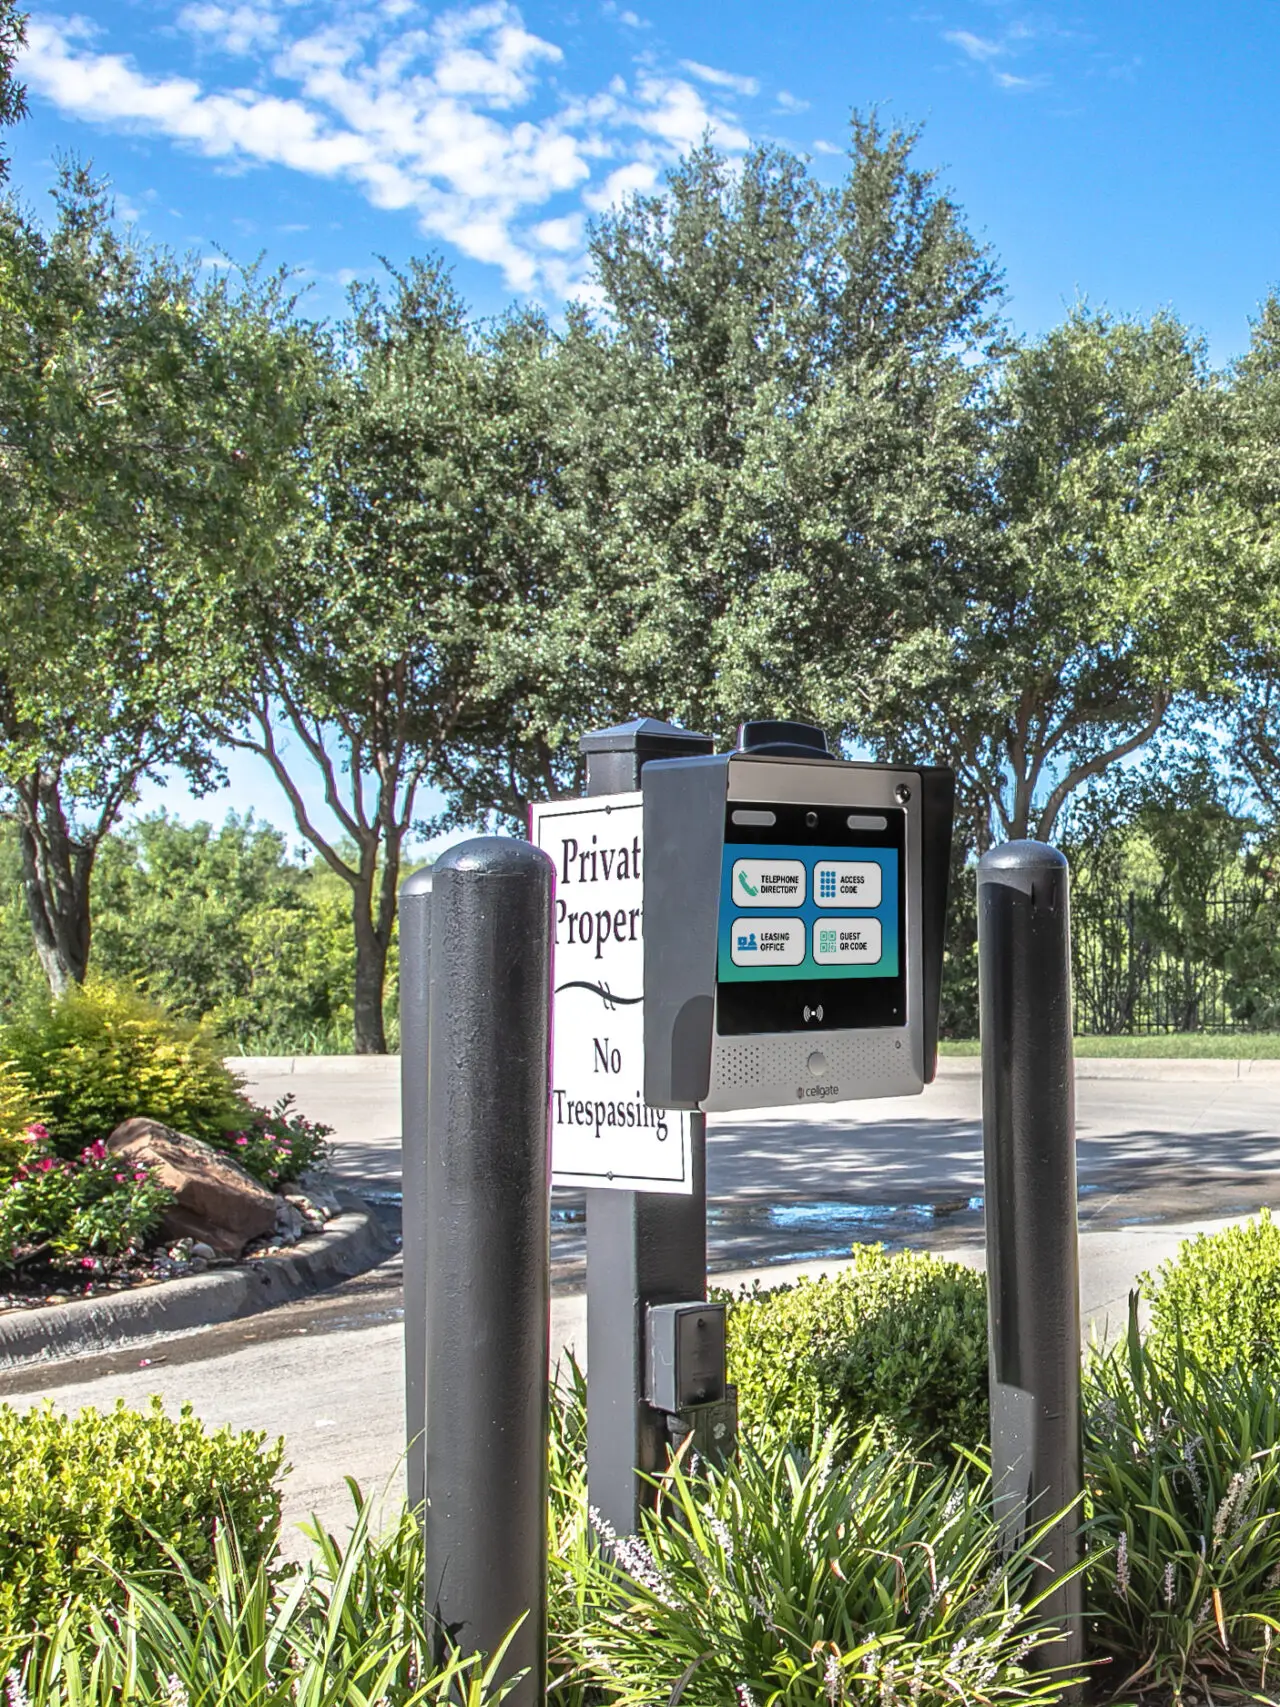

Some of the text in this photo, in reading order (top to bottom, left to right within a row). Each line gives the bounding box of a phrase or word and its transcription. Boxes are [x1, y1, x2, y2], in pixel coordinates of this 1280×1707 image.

[561, 835, 642, 884] Privat
[760, 874, 800, 884] TELEPHONE
[840, 875, 865, 884] ACCESS
[760, 885, 798, 894] DIRECTORY
[839, 885, 858, 894] CODE
[555, 899, 643, 960] Proper
[760, 932, 790, 941] LEASING
[839, 932, 861, 941] GUEST
[760, 943, 785, 952] OFFICE
[839, 942, 868, 951] QR CODE
[592, 1037, 622, 1074] No
[805, 1084, 840, 1099] cellgate
[552, 1089, 669, 1142] Trespassing
